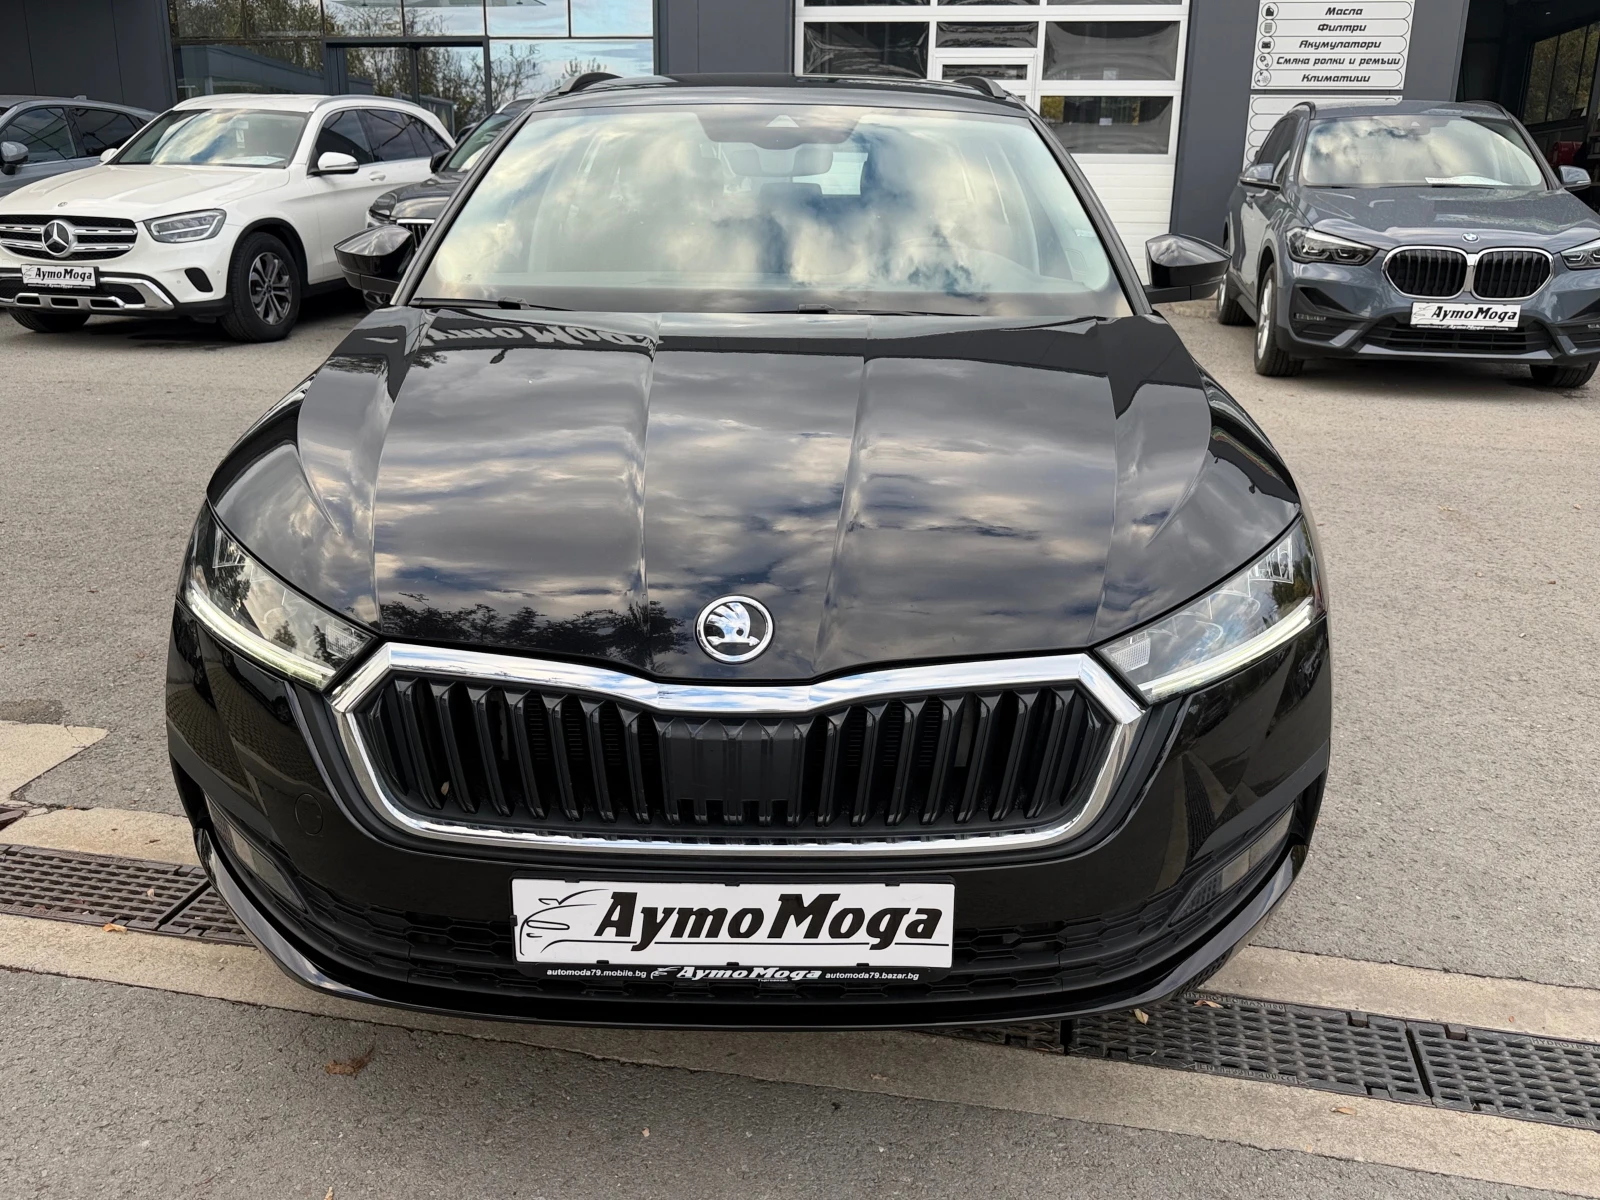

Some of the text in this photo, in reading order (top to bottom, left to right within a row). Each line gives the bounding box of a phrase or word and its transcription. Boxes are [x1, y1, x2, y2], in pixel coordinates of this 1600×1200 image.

[1325, 7, 1363, 15] Масла
[1317, 23, 1367, 33] Филтри
[1299, 40, 1382, 50] Акумулатори
[1276, 56, 1310, 65] Смяна
[1313, 58, 1346, 66] ролки
[546, 968, 647, 979] automoda79.mobile.bg
[825, 972, 920, 981] automoda79.bazar.bg
